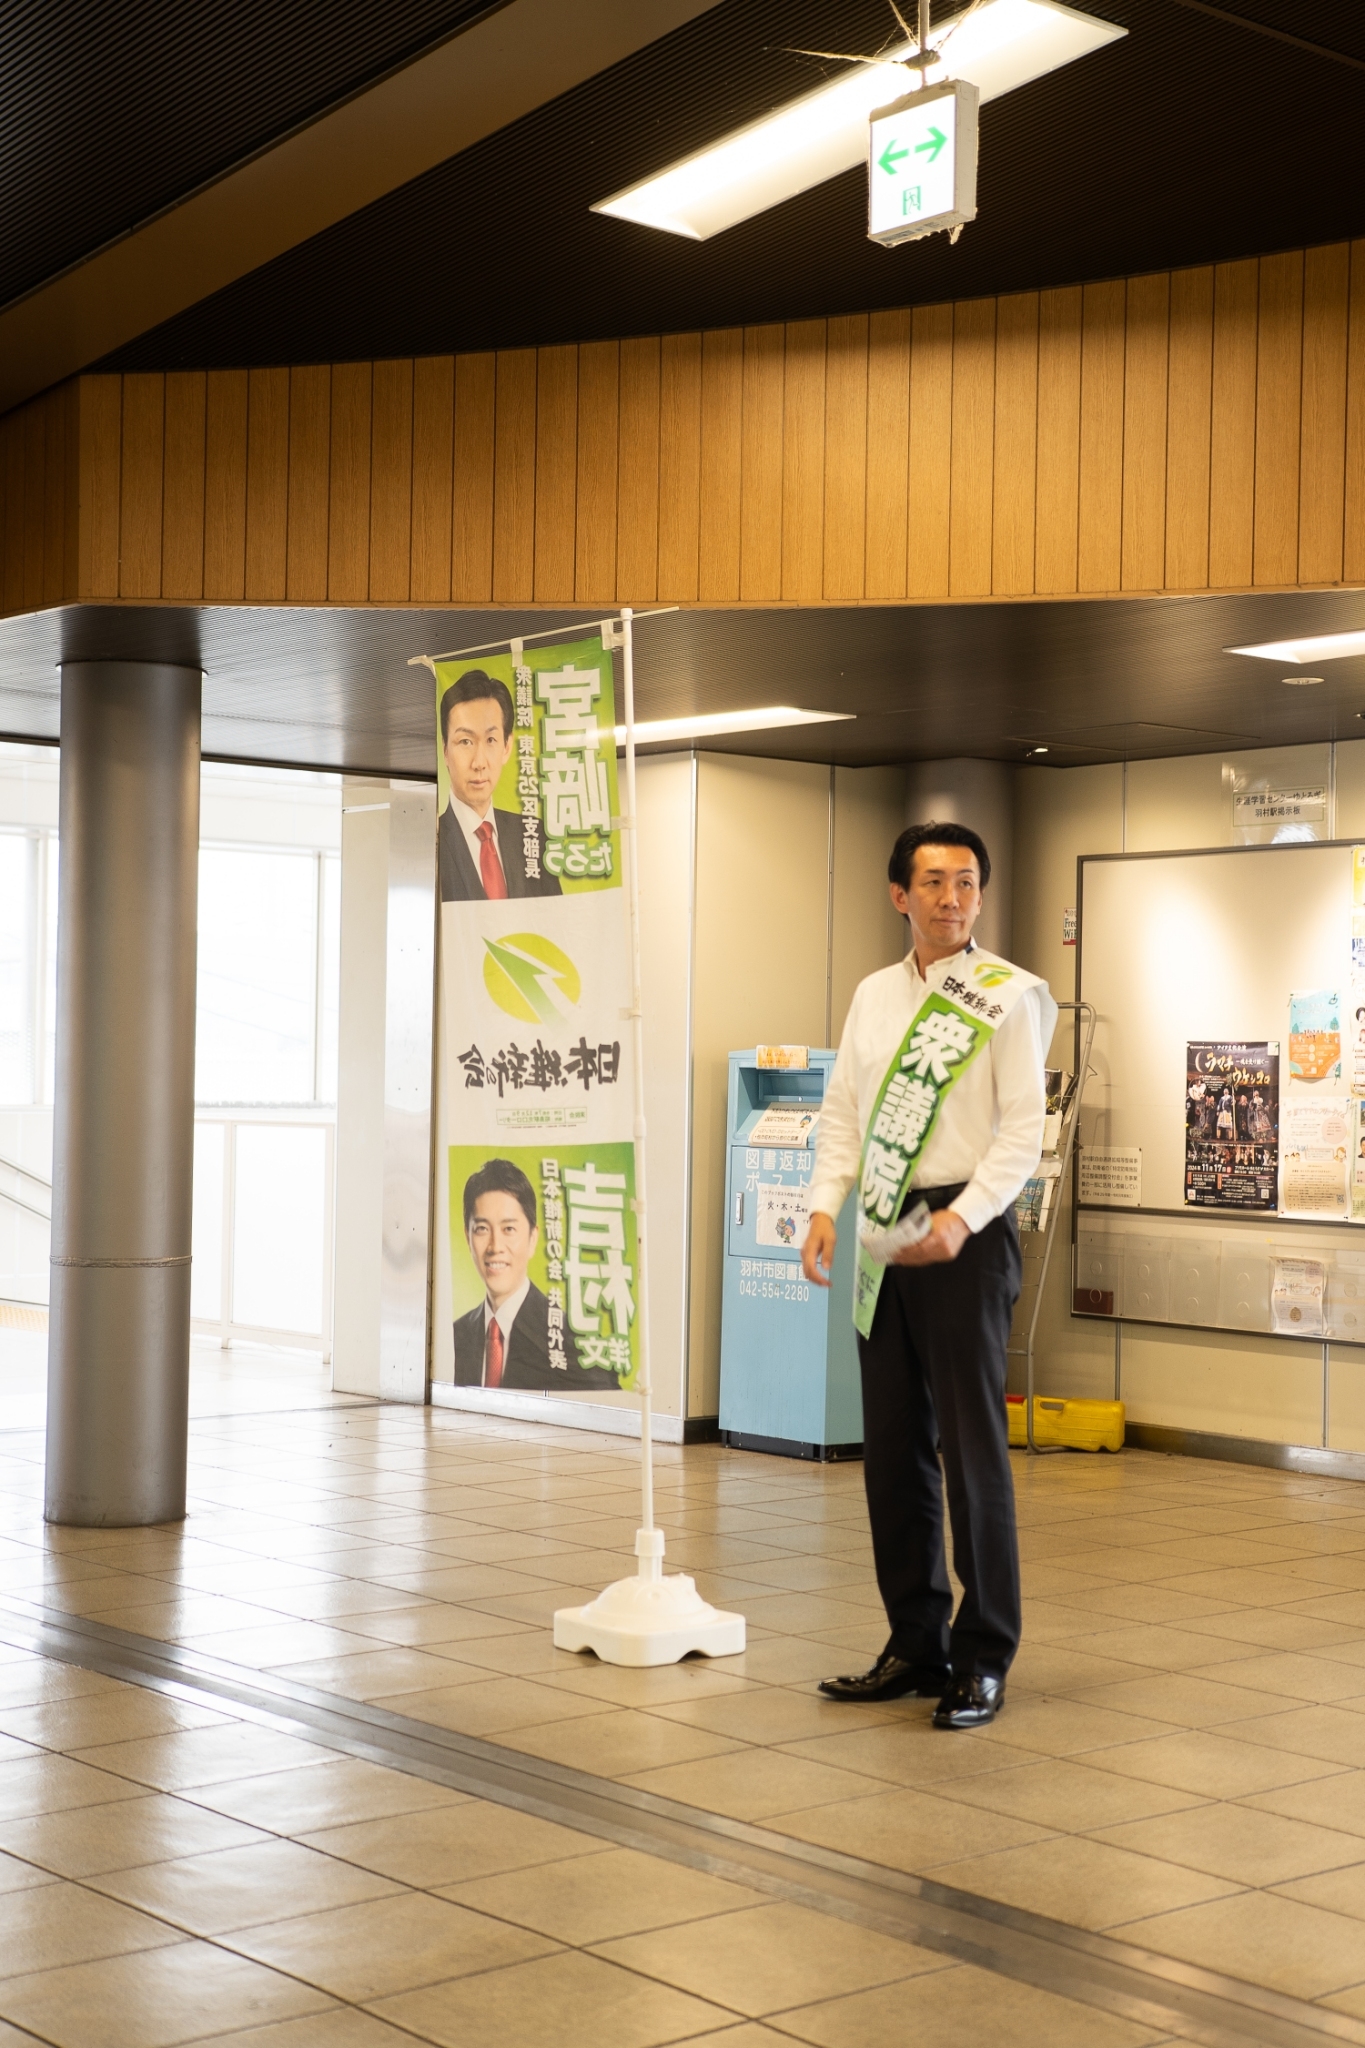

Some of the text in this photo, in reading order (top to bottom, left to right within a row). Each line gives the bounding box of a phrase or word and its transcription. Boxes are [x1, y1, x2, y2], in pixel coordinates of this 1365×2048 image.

[942, 975, 1004, 1021] 日本維新の会
[864, 1010, 978, 1222] 衆議院
[745, 1148, 811, 1172] 図書返却
[745, 1171, 810, 1193] ポスト
[740, 1279, 810, 1302] 042-554-2280
